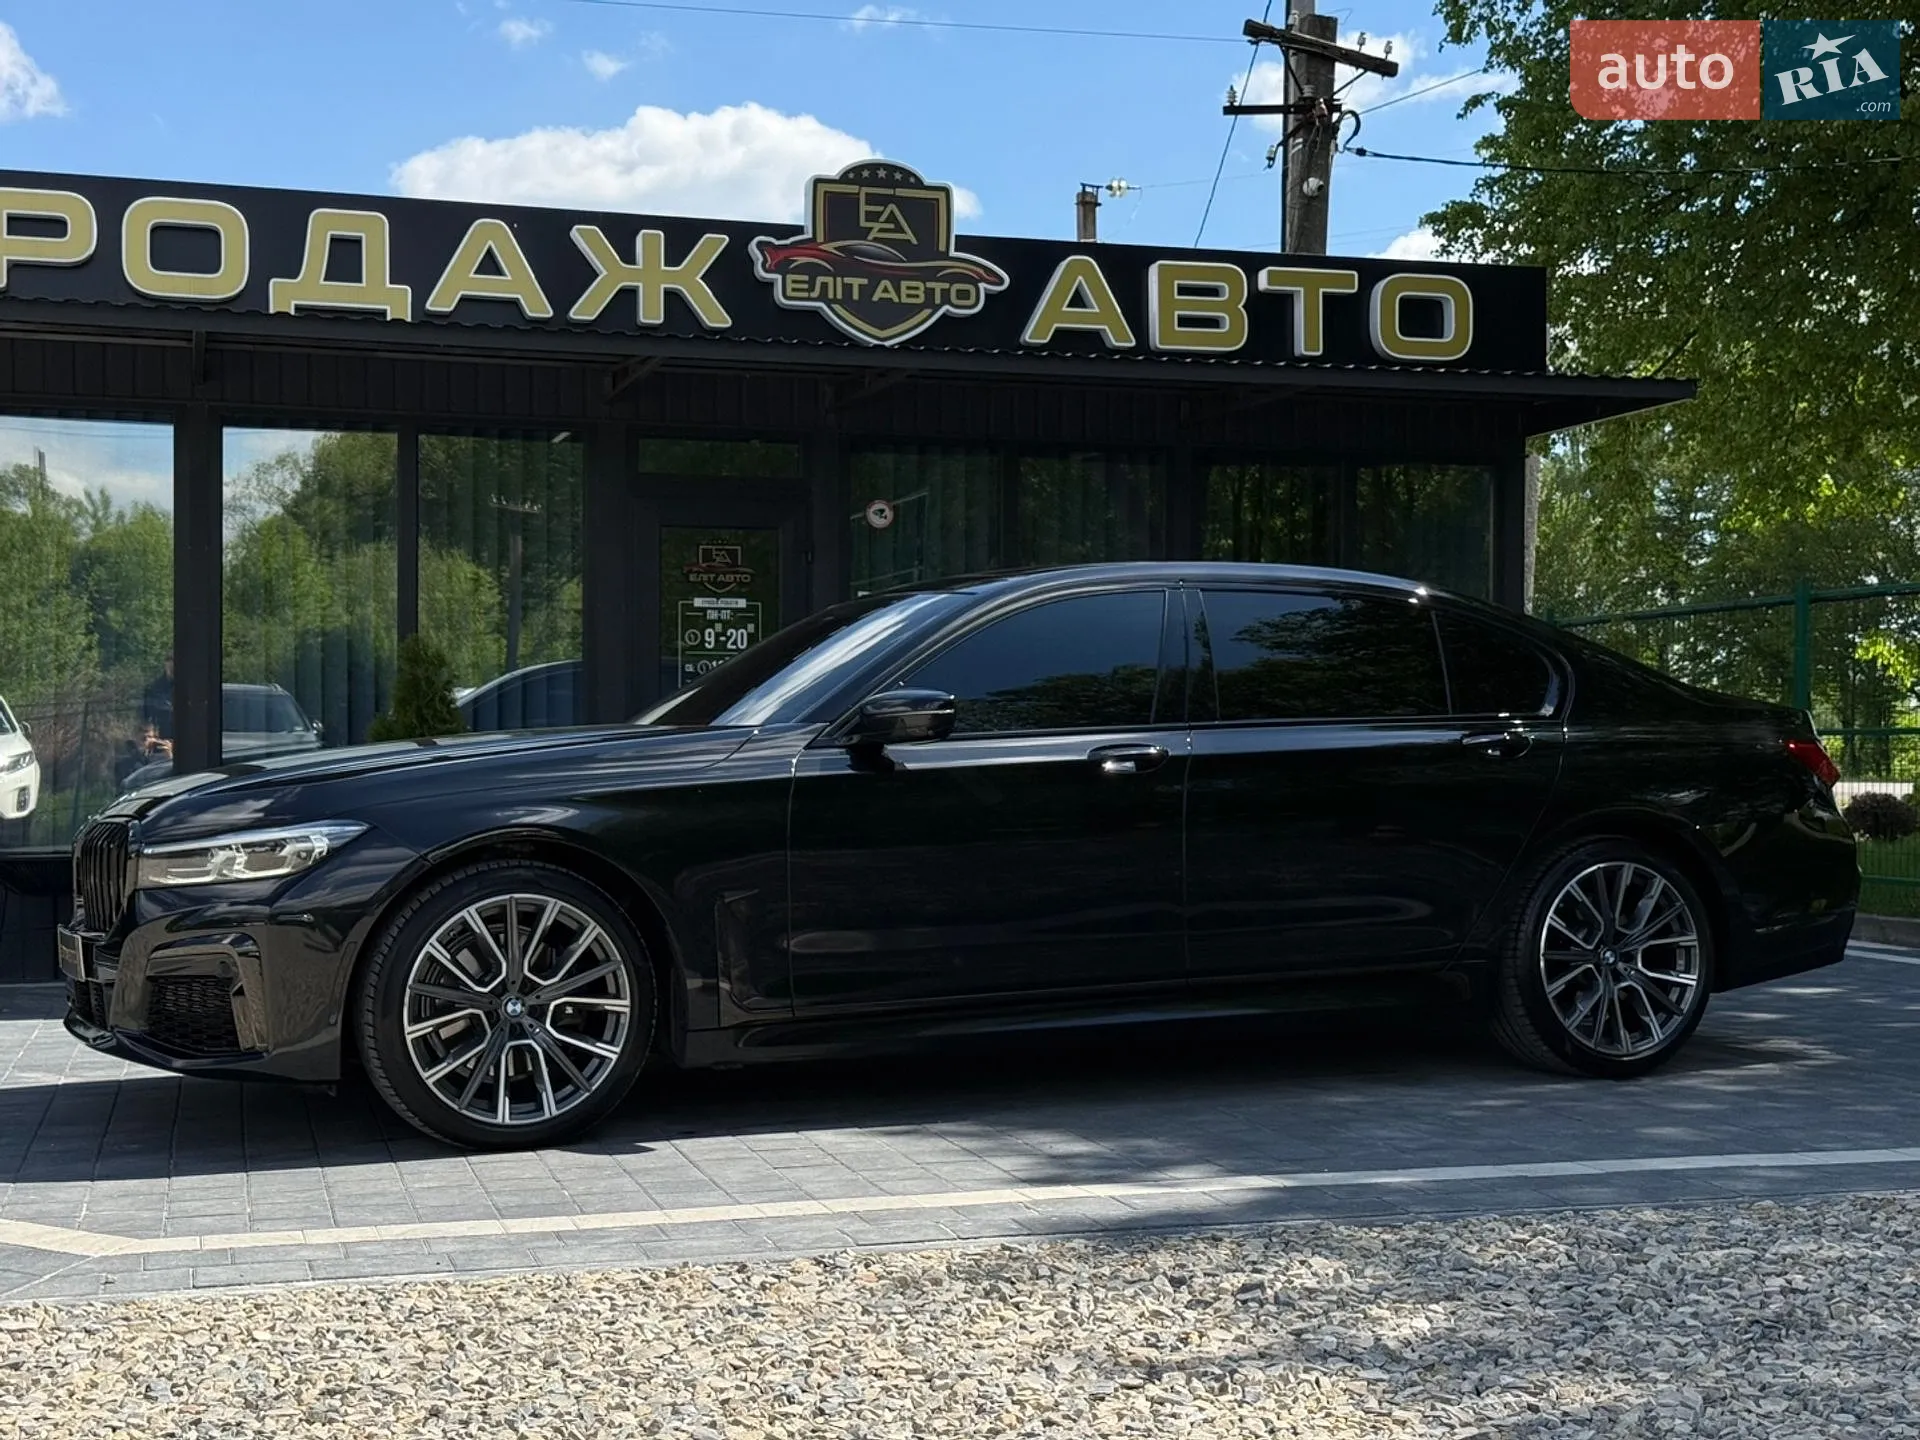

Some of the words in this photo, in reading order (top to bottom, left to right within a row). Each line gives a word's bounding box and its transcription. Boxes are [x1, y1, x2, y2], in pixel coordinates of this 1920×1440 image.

[0, 187, 732, 328] РОДАЖ
[785, 274, 868, 302] ЕЛІТ
[871, 280, 978, 306] АВТО
[1020, 255, 1474, 361] АВТО
